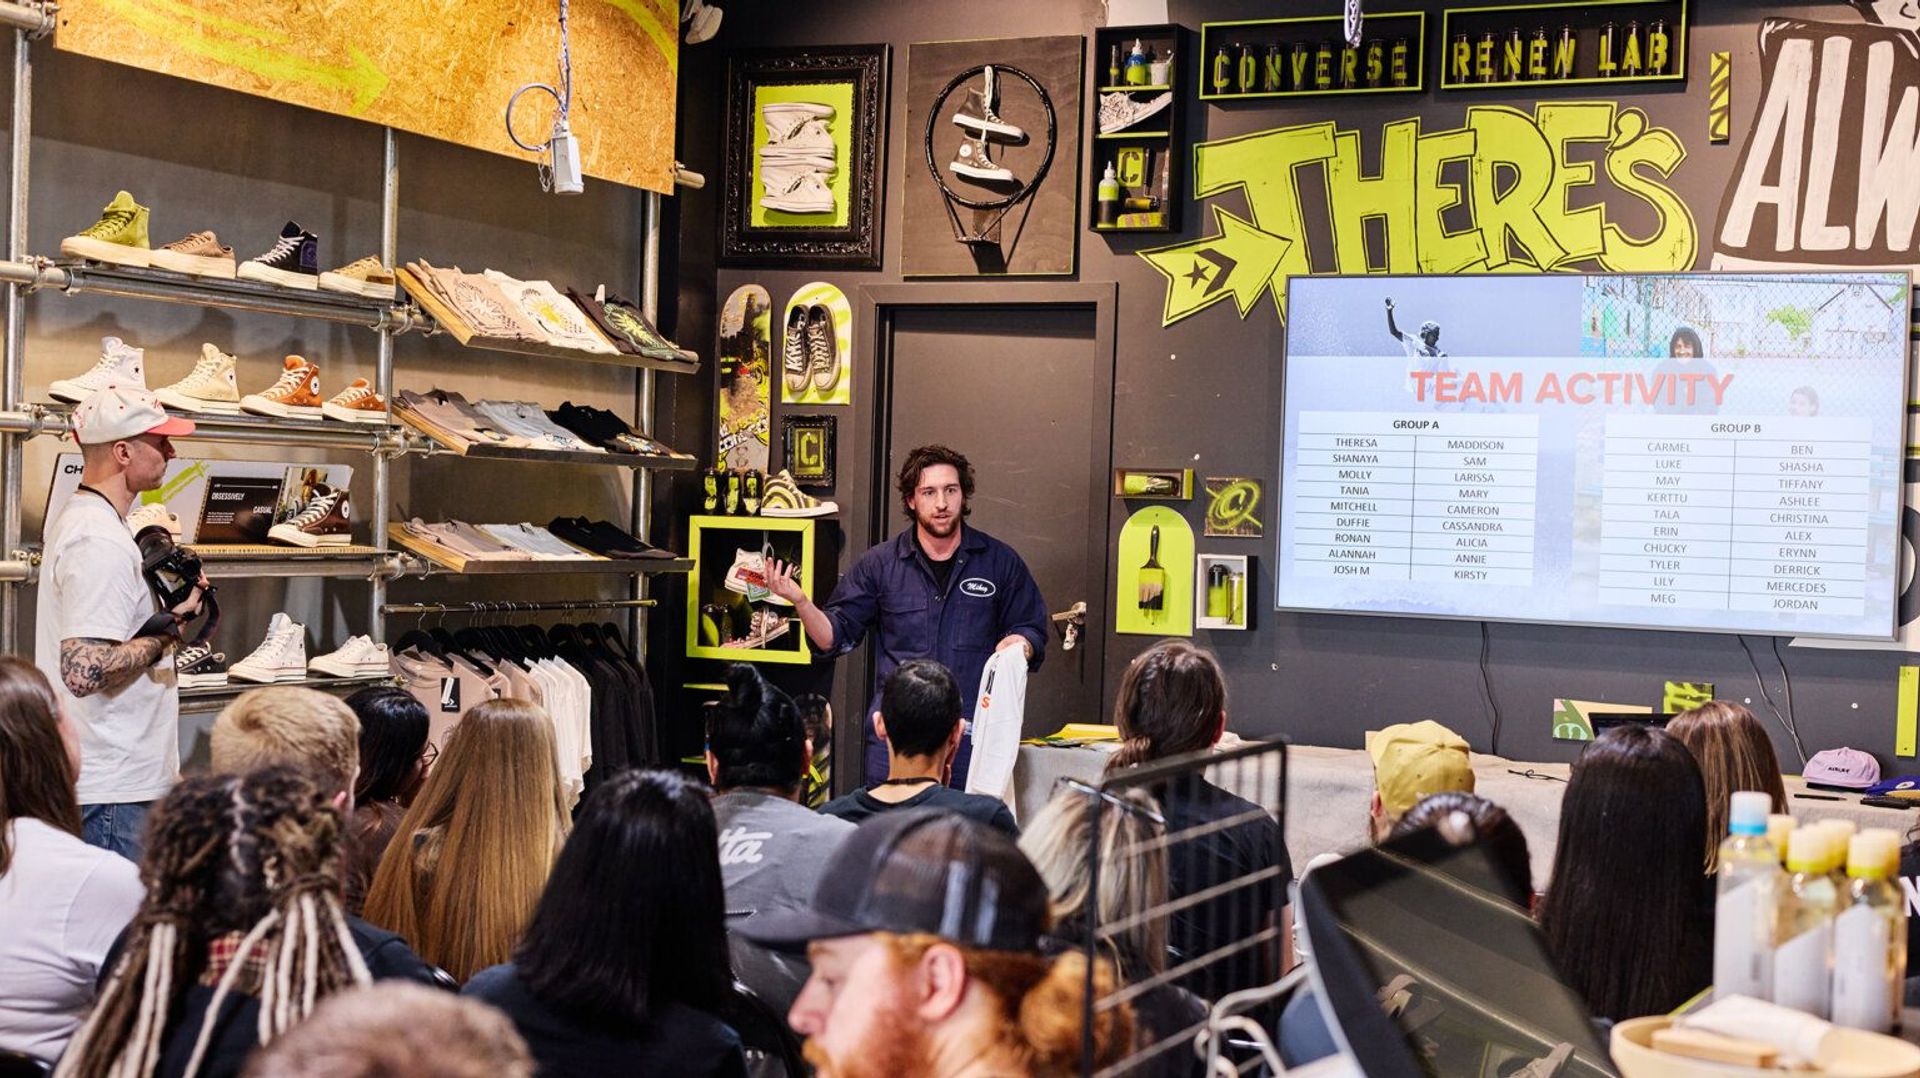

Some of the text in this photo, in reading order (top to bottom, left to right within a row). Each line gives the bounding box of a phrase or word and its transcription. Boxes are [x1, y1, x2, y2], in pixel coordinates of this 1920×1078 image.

[1452, 32, 1668, 76] RENEW LAB
[1213, 45, 1408, 89] CONVERSE
[1720, 36, 1920, 252] ALW
[1410, 371, 1734, 405] TEAM ACTIVITY
[1393, 419, 1440, 430] GROUP A
[1711, 423, 1761, 433] GROUP B
[1335, 438, 1378, 447] THERESA
[1448, 440, 1505, 450] MADDISON
[1647, 442, 1691, 453] CARMEL
[1791, 445, 1813, 455] BEN
[1332, 454, 1379, 464] SHANAYA
[1464, 457, 1486, 465] SAM
[1656, 459, 1681, 469] LUKE
[64, 464, 84, 475] CH
[1779, 462, 1823, 472] SHASHA
[1338, 470, 1372, 480] MOLLY
[1455, 473, 1495, 482] LARISSA
[1656, 476, 1681, 486] MAY
[1779, 479, 1823, 489] TIFFANY
[1340, 486, 1369, 495] TANIA
[1459, 489, 1489, 499] MARY
[211, 492, 245, 500] OBSESSIVELY
[1647, 492, 1688, 503] KERTTU
[1779, 496, 1820, 506] ASHLEE
[253, 506, 272, 514] CASUAL
[1330, 502, 1377, 512] MITCHELL
[1447, 505, 1500, 515] CAMERON
[1654, 510, 1680, 519] TALA
[1770, 513, 1829, 524] CHRISTINA
[1336, 518, 1370, 528] DUFFIE
[1443, 521, 1503, 532] CASSANDRA
[1653, 527, 1678, 536] ERIN
[1785, 531, 1812, 541] ALEX
[1335, 533, 1371, 543] RONAN
[1456, 538, 1488, 547] ALICIA
[1643, 543, 1687, 553] CHUCKY
[1779, 548, 1816, 558] ERYNN
[1328, 549, 1376, 559] ALANNAH
[1456, 554, 1486, 563] ANNIE
[1333, 565, 1369, 575] JOSH M
[1650, 560, 1680, 570] TYLER
[1774, 564, 1820, 575] DERRICK
[1454, 570, 1488, 580] KIRSTY
[1654, 577, 1674, 587] LILY
[1766, 582, 1827, 592] MERCEDES
[1651, 594, 1676, 604] MEG
[1773, 599, 1818, 610] JORDAN
[718, 826, 773, 866] tta
